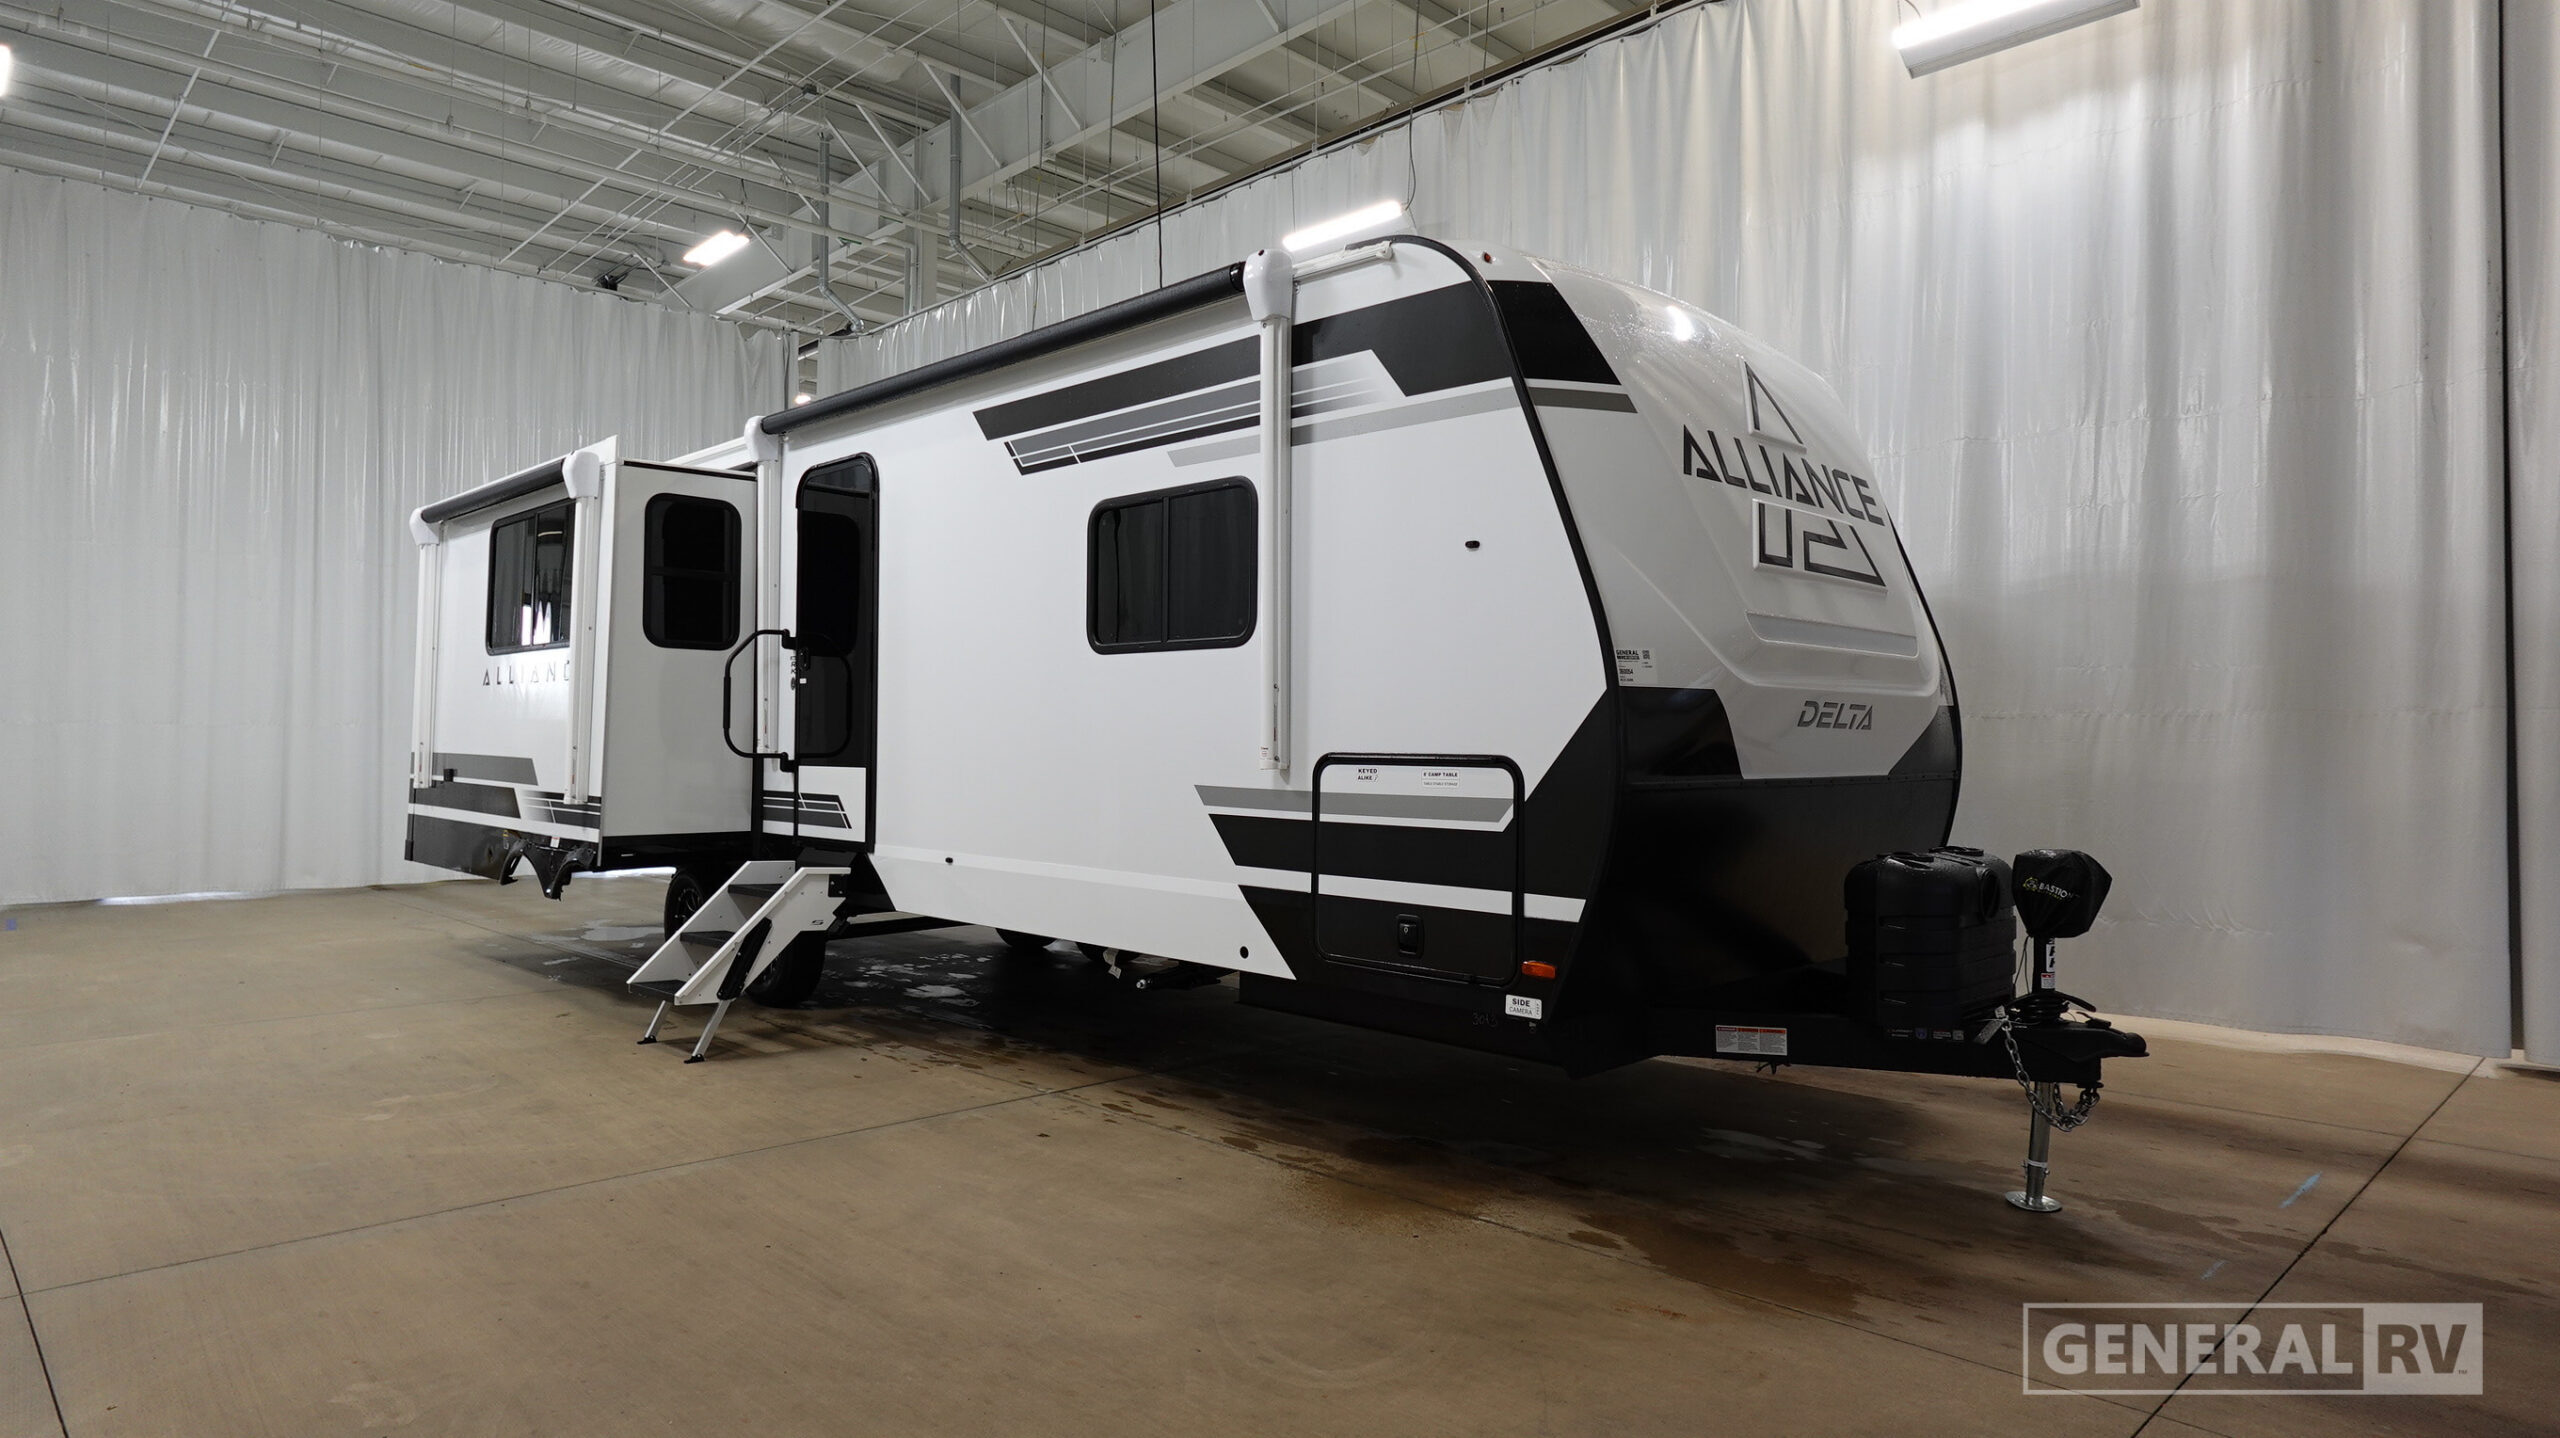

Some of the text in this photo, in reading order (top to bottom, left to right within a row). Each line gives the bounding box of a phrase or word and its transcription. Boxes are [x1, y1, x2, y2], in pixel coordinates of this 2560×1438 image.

[1683, 424, 1885, 527] ALLIANCE
[482, 660, 570, 686] ALLIANC
[1797, 700, 1873, 731] DELTA
[1509, 1006, 1533, 1016] CAMERA
[1512, 998, 1531, 1007] SIDE
